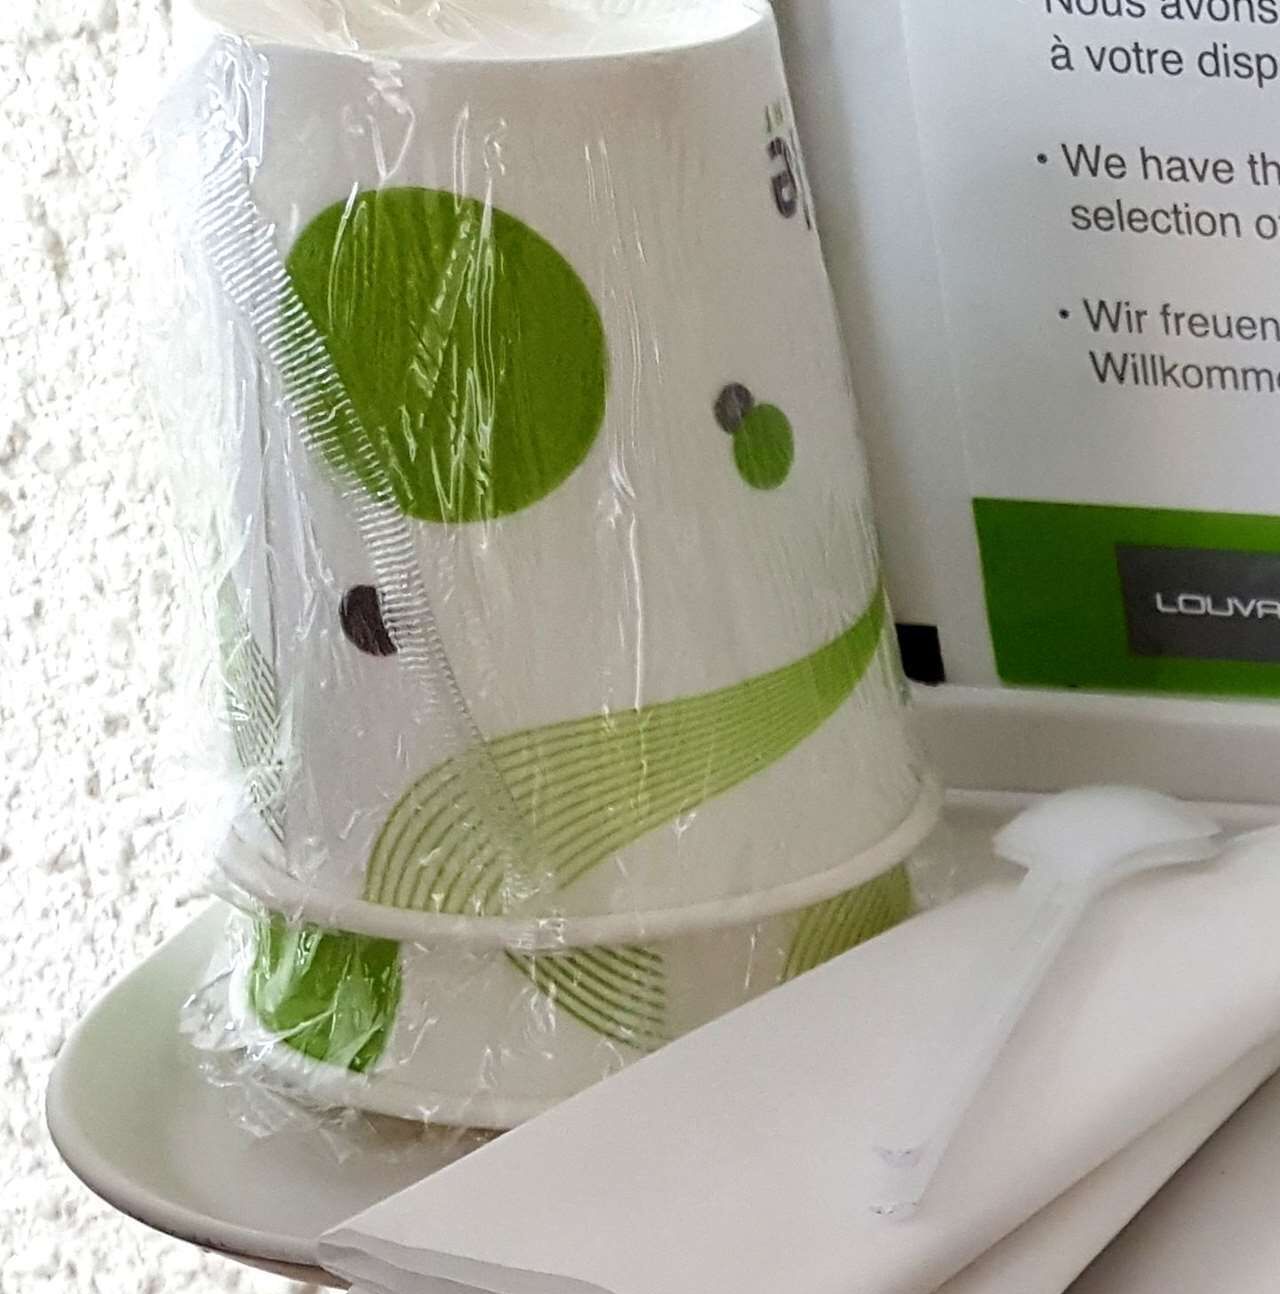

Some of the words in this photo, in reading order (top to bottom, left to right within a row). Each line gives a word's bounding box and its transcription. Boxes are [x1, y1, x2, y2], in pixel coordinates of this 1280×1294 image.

[1159, 0, 1279, 25] avons
[1050, 33, 1075, 72] à
[1084, 41, 1185, 77] votre
[1060, 142, 1128, 180] We
[1139, 145, 1235, 185] have
[1070, 198, 1242, 239] selection
[1082, 297, 1148, 335] Wir
